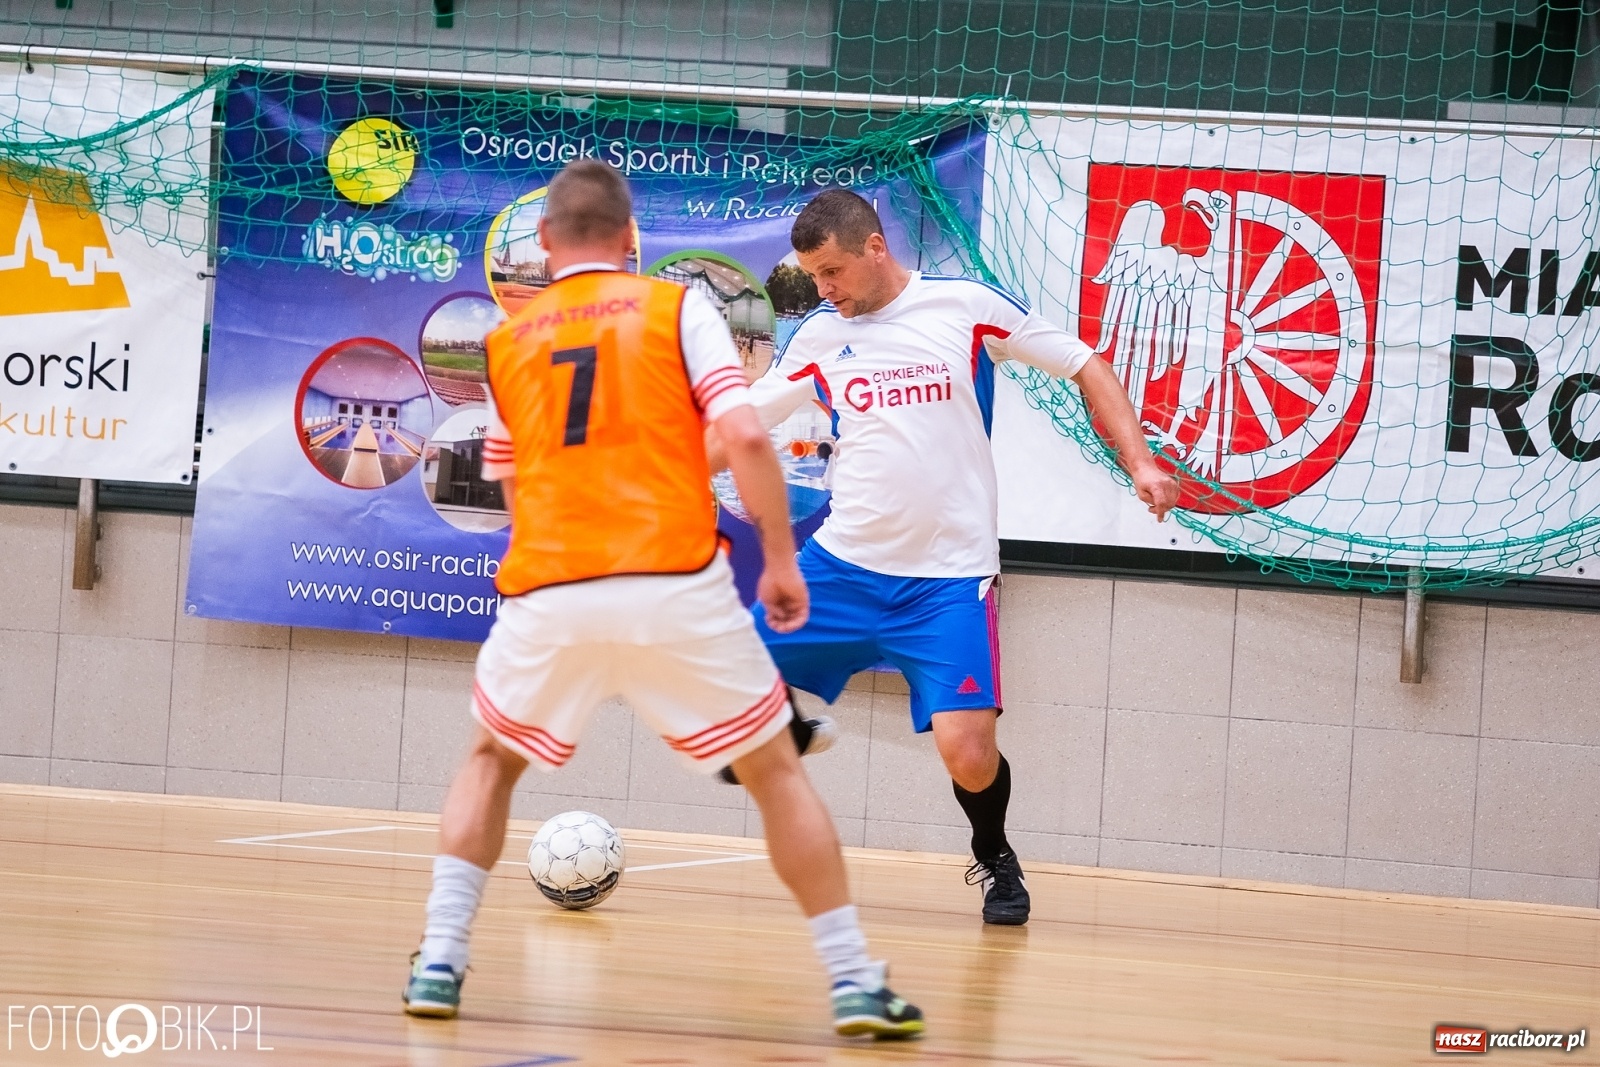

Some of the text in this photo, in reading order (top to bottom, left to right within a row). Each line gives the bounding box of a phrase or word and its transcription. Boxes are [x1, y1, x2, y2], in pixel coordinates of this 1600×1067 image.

[607, 141, 710, 177] Sportu
[722, 153, 730, 179] i
[687, 199, 715, 219] w
[537, 297, 641, 332] PATRICK
[3, 341, 130, 392] orski
[872, 363, 950, 383] CUKIERNIA
[551, 345, 597, 446] 7
[844, 376, 951, 412] Gianni
[0, 402, 128, 440] kultur
